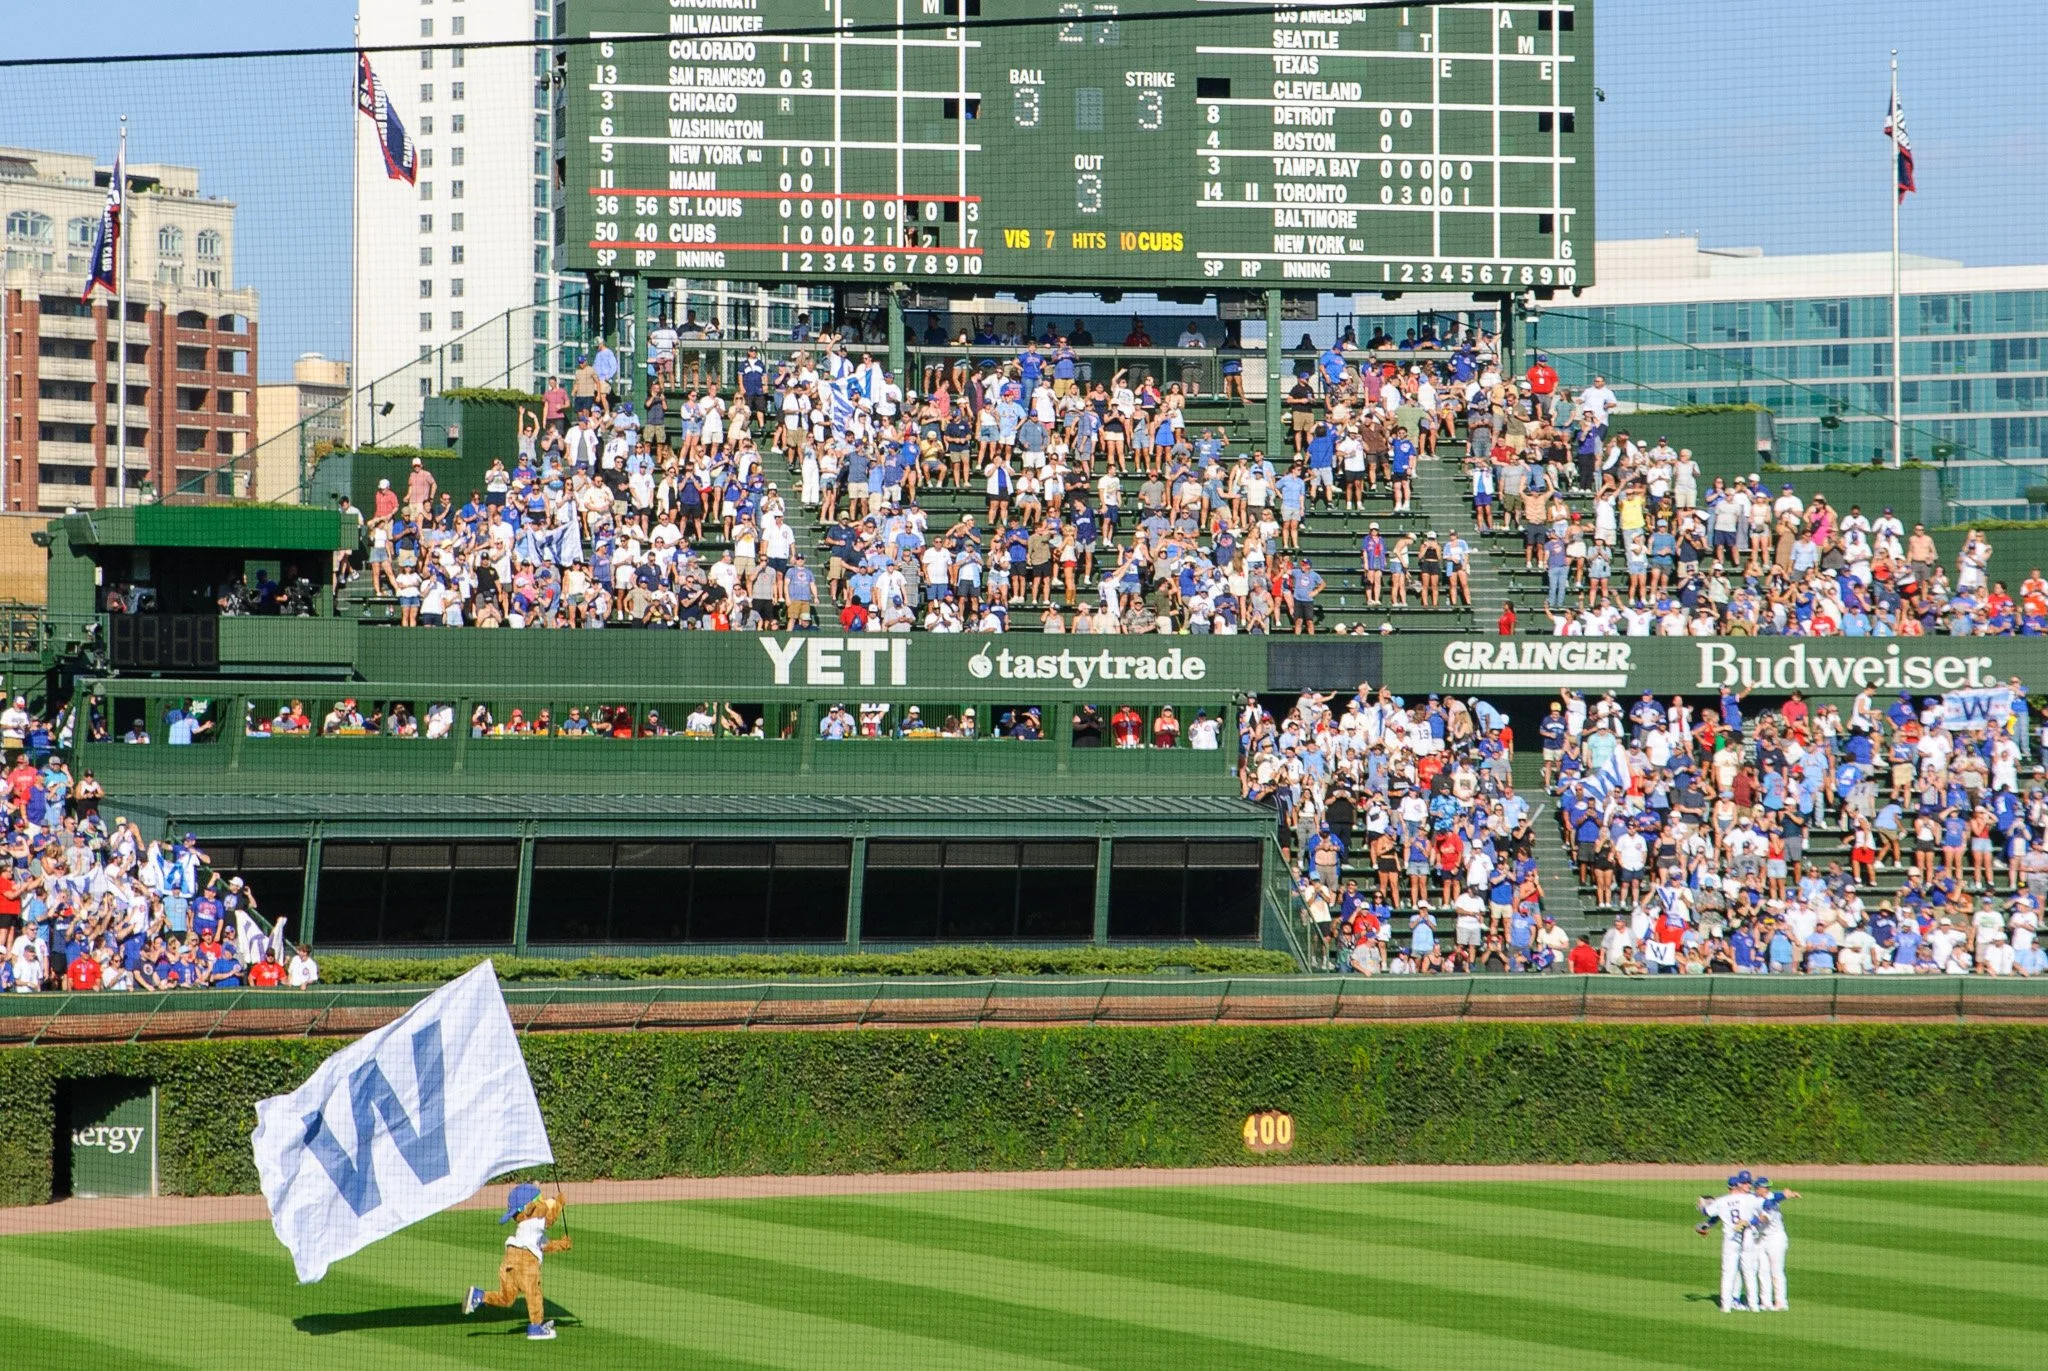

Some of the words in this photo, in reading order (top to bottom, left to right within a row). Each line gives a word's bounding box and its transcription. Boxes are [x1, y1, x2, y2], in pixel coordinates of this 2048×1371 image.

[670, 15, 763, 34] MILWAUKEE
[1500, 10, 1512, 28] A
[600, 42, 614, 58] 6
[669, 40, 756, 60] COLORADO
[1273, 30, 1339, 48] SEATTLE
[1420, 34, 1432, 52] T
[1518, 36, 1534, 54] M
[597, 65, 618, 84] 13
[669, 66, 694, 86] SAN
[697, 67, 766, 87] FRANCISCO
[779, 69, 792, 88] 0
[801, 70, 812, 88] 3
[1010, 69, 1045, 84] BALL
[1126, 72, 1176, 87] STRIKE
[1273, 56, 1319, 74] TEXAS
[1441, 60, 1452, 78] E
[1540, 62, 1552, 80] E
[1274, 80, 1362, 100] CLEVELAND
[601, 92, 614, 110] 3
[669, 93, 737, 112] CHICAGO
[1015, 88, 1039, 126] 3
[1139, 90, 1162, 129] 3
[600, 118, 614, 136] 6
[669, 119, 764, 139] WASHINGTON
[1207, 106, 1220, 124] 8
[1274, 106, 1336, 126] DETROIT
[1380, 109, 1392, 128] 0
[1400, 110, 1412, 128] 0
[1207, 131, 1220, 148] 4
[1274, 132, 1336, 151] BOSTON
[1380, 134, 1392, 152] 0
[601, 144, 614, 162] 5
[669, 145, 701, 164] NEW
[704, 146, 743, 165] YORK
[800, 148, 813, 166] 0
[1074, 154, 1104, 170] OUT
[1208, 156, 1220, 175] 3
[1273, 158, 1326, 176] TAMPA
[1330, 159, 1360, 178] BAY
[1380, 160, 1392, 178] 0
[1400, 160, 1412, 179] 0
[1420, 161, 1432, 180] 0
[1440, 162, 1452, 180] 0
[1460, 162, 1472, 180] 0
[669, 171, 716, 190] MIAMI
[780, 172, 792, 192] 0
[800, 173, 813, 192] 0
[1078, 174, 1102, 212] 3
[1204, 182, 1223, 200] 14
[1274, 183, 1347, 203] TORONTO
[1380, 186, 1392, 204] 0
[1401, 186, 1412, 204] 3
[1420, 186, 1432, 204] 0
[1440, 187, 1452, 205] 0
[596, 196, 618, 216] 36
[636, 197, 658, 216] 56
[669, 197, 692, 216] ST.
[697, 198, 742, 217] LOUIS
[780, 199, 792, 218] 0
[800, 200, 813, 219] 0
[822, 200, 834, 219] 0
[862, 200, 875, 220] 0
[884, 201, 896, 220] 0
[926, 202, 938, 221] 0
[968, 202, 978, 222] 3
[1274, 209, 1358, 228] BALTIMORE
[595, 222, 618, 242] 50
[634, 223, 658, 242] 40
[669, 223, 716, 243] CUBS
[800, 226, 813, 244] 0
[822, 226, 834, 245] 0
[842, 226, 854, 245] 0
[864, 227, 874, 246] 2
[968, 229, 978, 248] 7
[1004, 230, 1031, 248] VIS
[1045, 230, 1056, 248] 7
[1072, 232, 1107, 249] HITS
[1120, 232, 1137, 250] 10
[1138, 232, 1184, 252] CUBS
[1274, 234, 1304, 252] NEW
[1307, 235, 1346, 254] YORK
[1561, 240, 1572, 258] 6
[597, 249, 617, 266] SP
[636, 250, 656, 266] RP
[676, 251, 726, 268] INNING
[800, 254, 812, 272] 2
[824, 254, 836, 272] 3
[842, 254, 854, 272] 4
[863, 255, 875, 272] 5
[884, 255, 896, 273] 6
[906, 256, 918, 273] 7
[925, 255, 938, 274] 8
[946, 256, 958, 274] 9
[964, 256, 982, 274] 10
[1204, 260, 1224, 276] SP
[1241, 261, 1262, 277] RP
[1283, 262, 1331, 278] INNING
[1401, 264, 1413, 282] 2
[1421, 264, 1433, 282] 3
[1440, 265, 1454, 283] 4
[1461, 265, 1473, 283] 5
[1480, 266, 1492, 284] 6
[1501, 266, 1513, 284] 7
[1520, 266, 1533, 284] 8
[1540, 266, 1552, 284] 9
[1558, 266, 1576, 285] 10
[758, 637, 906, 686] YETI
[1444, 640, 1632, 670] GRAINGER
[1696, 642, 1993, 689] Budweiser
[996, 648, 1206, 688] tastytrade
[301, 1019, 450, 1217] W
[1244, 1114, 1290, 1144] 400
